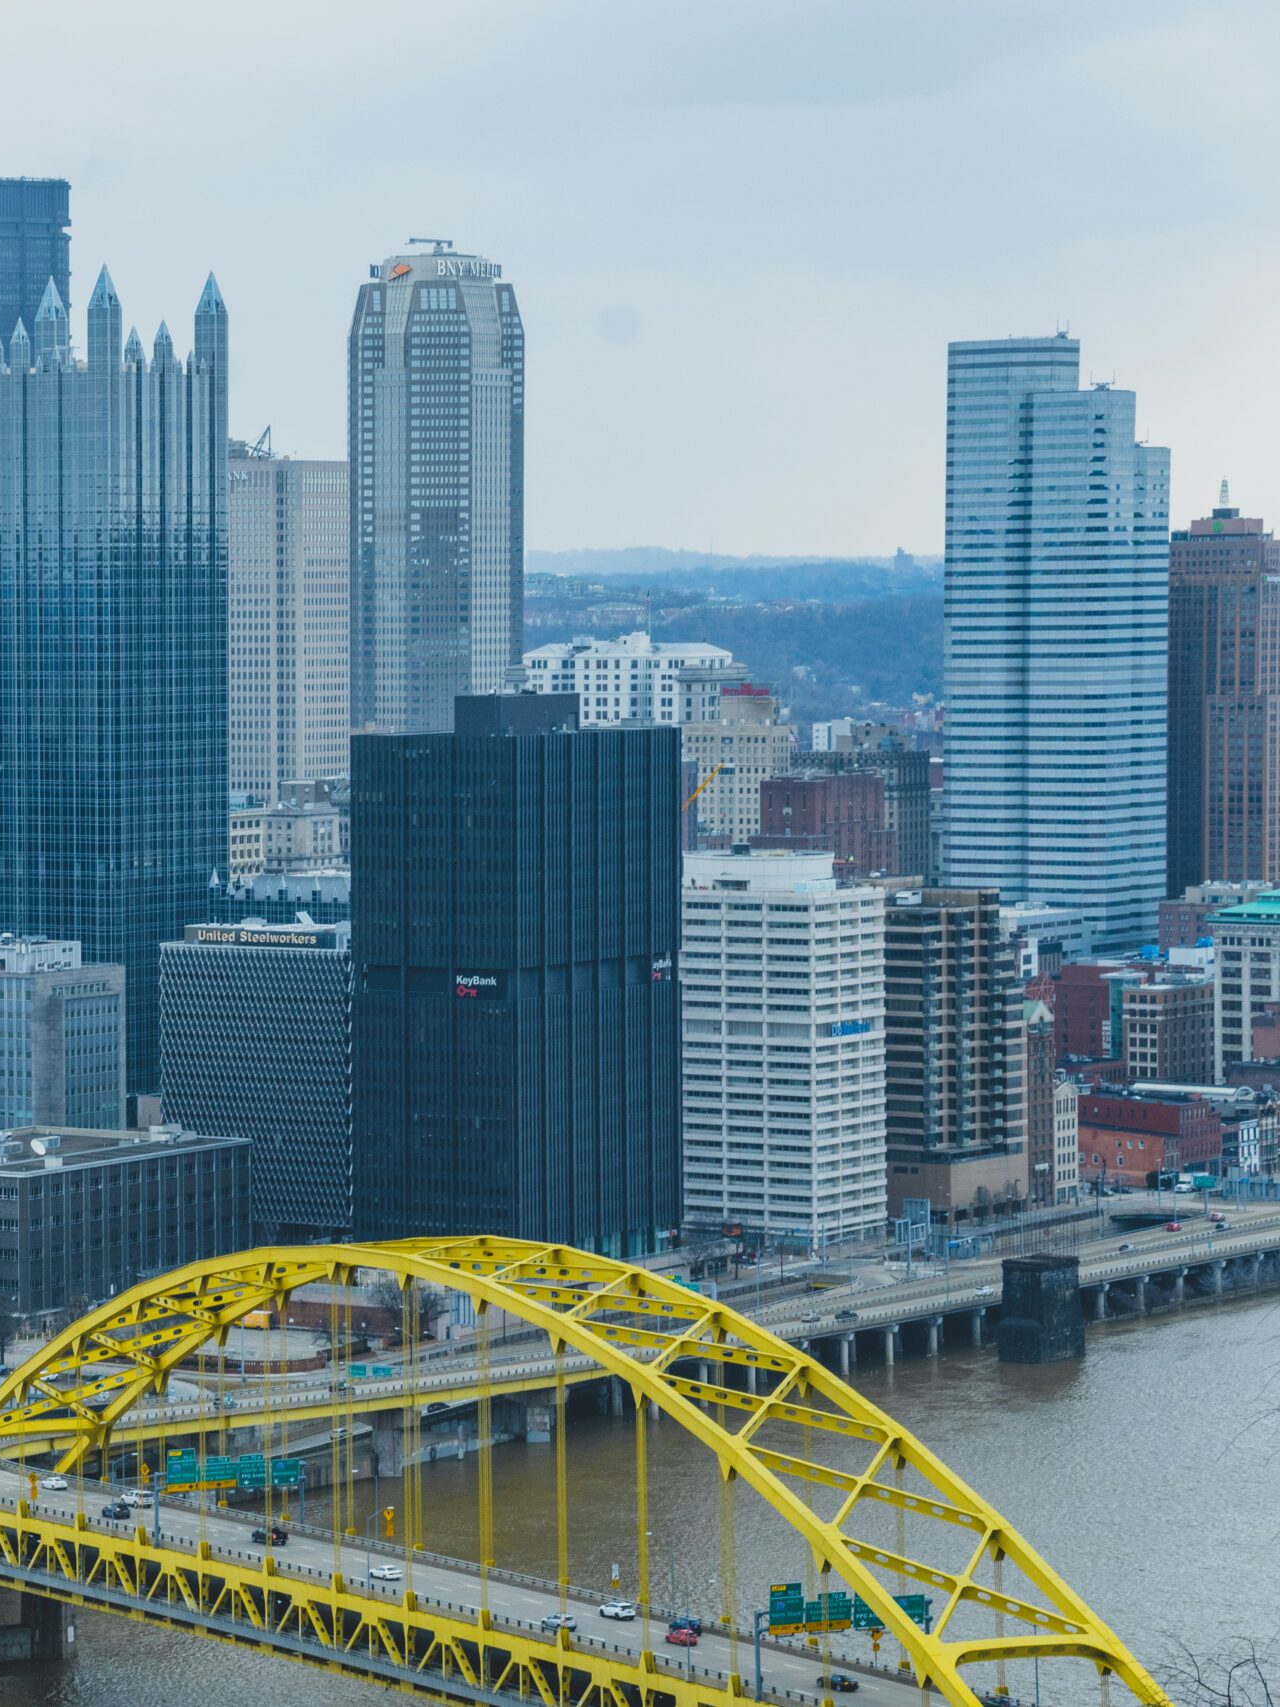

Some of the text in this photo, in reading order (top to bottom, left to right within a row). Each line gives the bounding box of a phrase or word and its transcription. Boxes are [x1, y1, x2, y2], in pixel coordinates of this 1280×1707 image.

[437, 260, 466, 276] BNY
[198, 930, 317, 944] United Steelworkers
[456, 975, 496, 986] KeyBank
